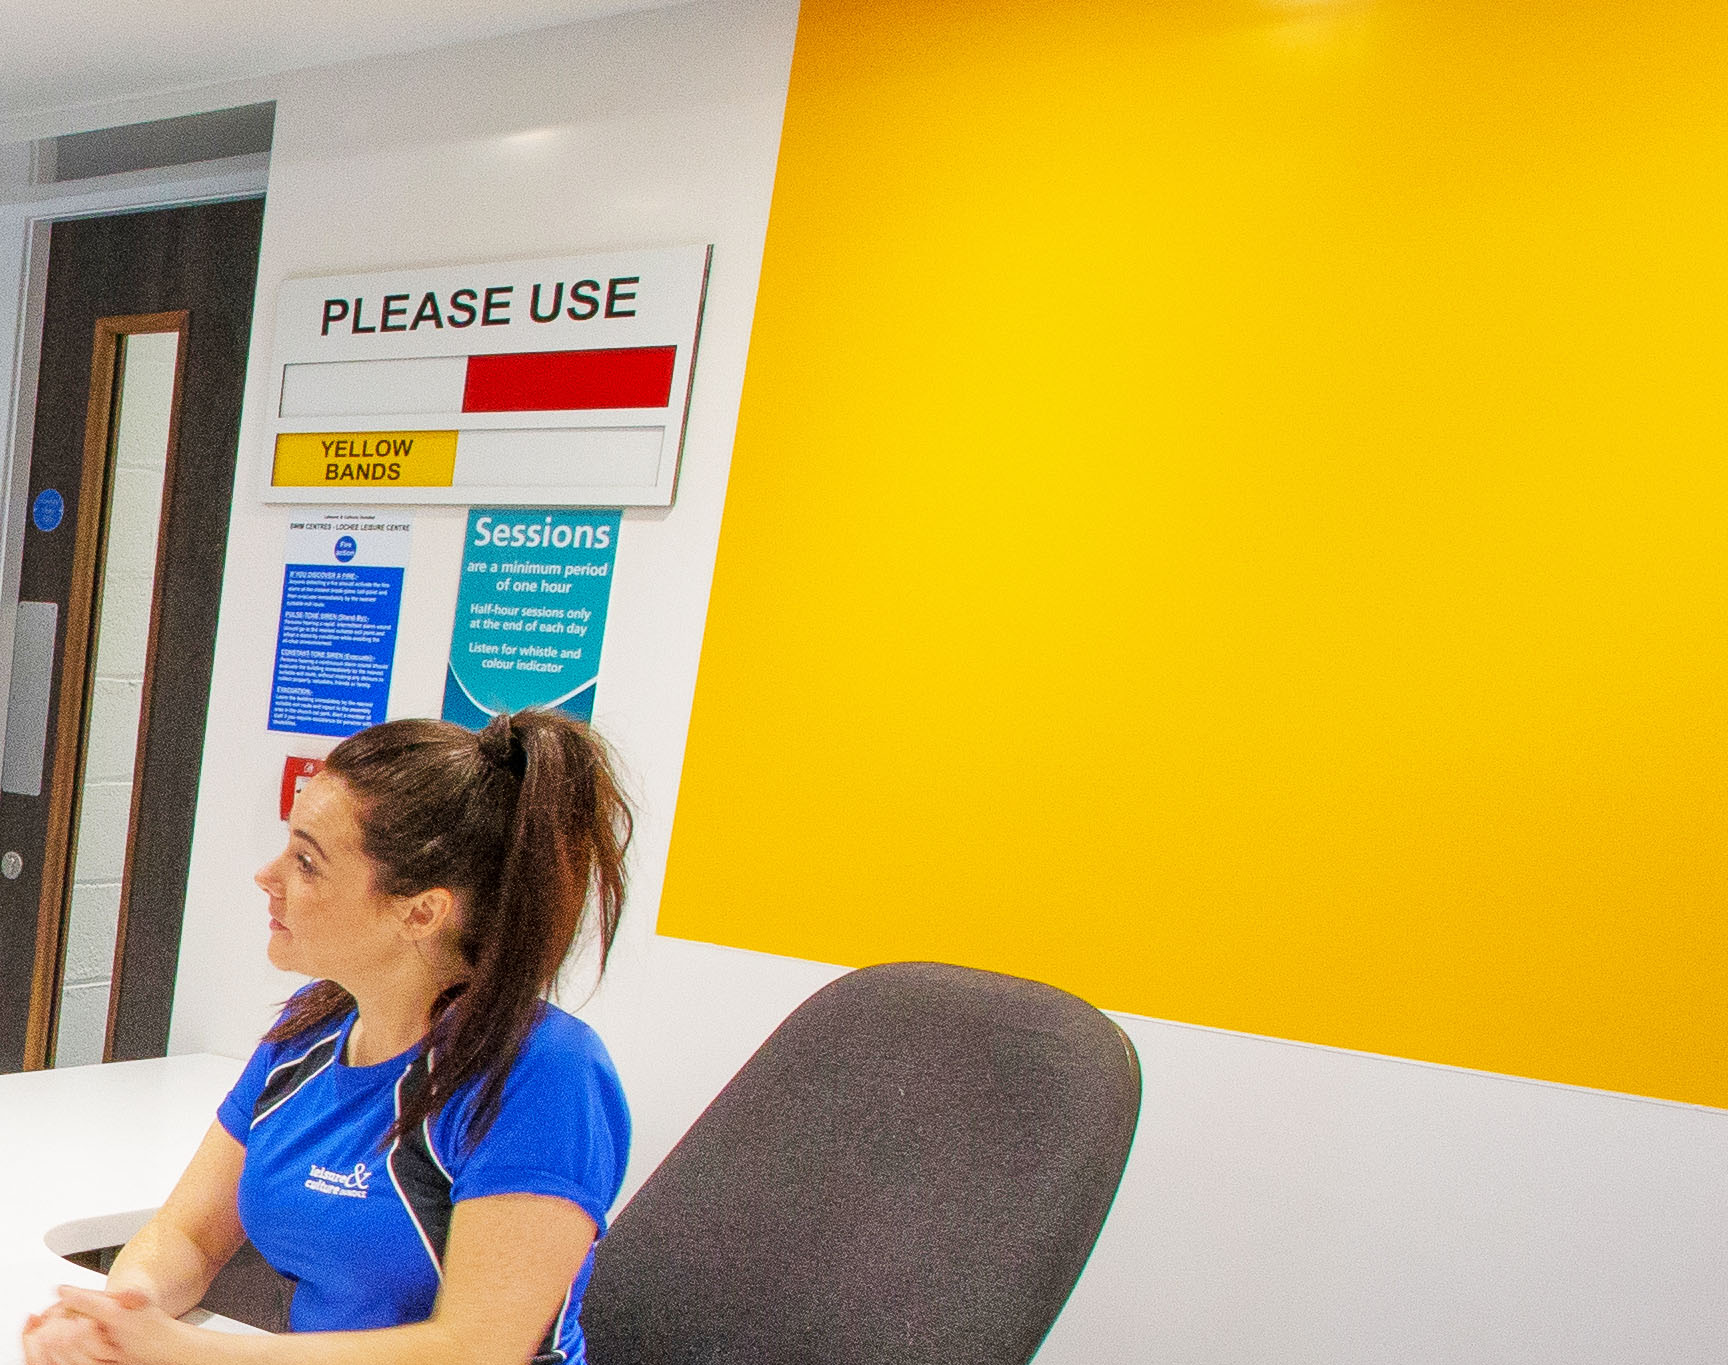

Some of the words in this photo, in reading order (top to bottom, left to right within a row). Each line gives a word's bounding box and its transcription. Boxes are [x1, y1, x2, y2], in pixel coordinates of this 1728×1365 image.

[321, 286, 514, 336] PLEASE
[530, 276, 640, 323] USE
[321, 439, 413, 458] YELLOW
[325, 463, 400, 480] BANDS
[474, 516, 610, 549] Sessions
[467, 562, 487, 572] are
[490, 563, 497, 572] a
[502, 561, 561, 575] minimum
[564, 563, 608, 578] period
[496, 578, 511, 591] of
[513, 581, 537, 592] one
[541, 580, 572, 594] hour
[470, 603, 519, 616] Half-hour
[521, 607, 564, 618] sessions
[567, 608, 591, 622] only
[470, 620, 481, 628] at
[484, 619, 500, 630] the
[503, 620, 523, 631] end
[525, 621, 538, 632] of
[540, 622, 564, 633] each
[567, 623, 587, 637] day
[469, 642, 498, 654] Listen
[502, 643, 517, 655] for
[520, 646, 558, 657] whistle
[561, 648, 581, 659] and
[482, 659, 514, 670] colour
[517, 660, 564, 673] indicator
[345, 1163, 372, 1189] &
